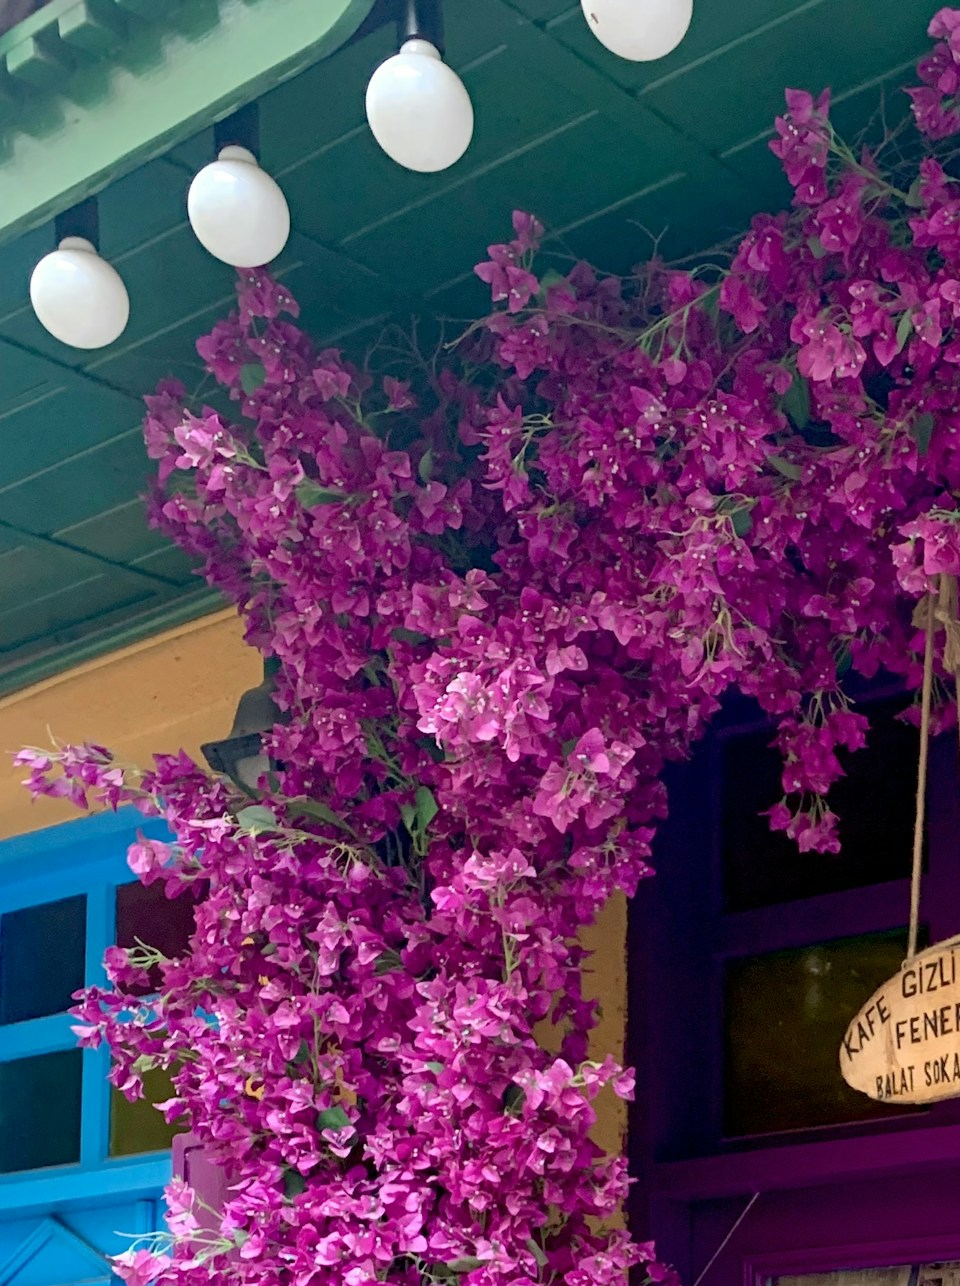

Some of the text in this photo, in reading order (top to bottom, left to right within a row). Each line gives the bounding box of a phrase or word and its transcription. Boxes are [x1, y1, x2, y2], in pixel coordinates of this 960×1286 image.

[843, 995, 892, 1062] KAFE
[901, 949, 956, 999] GİZLİ
[875, 1065, 916, 1101] BALAT
